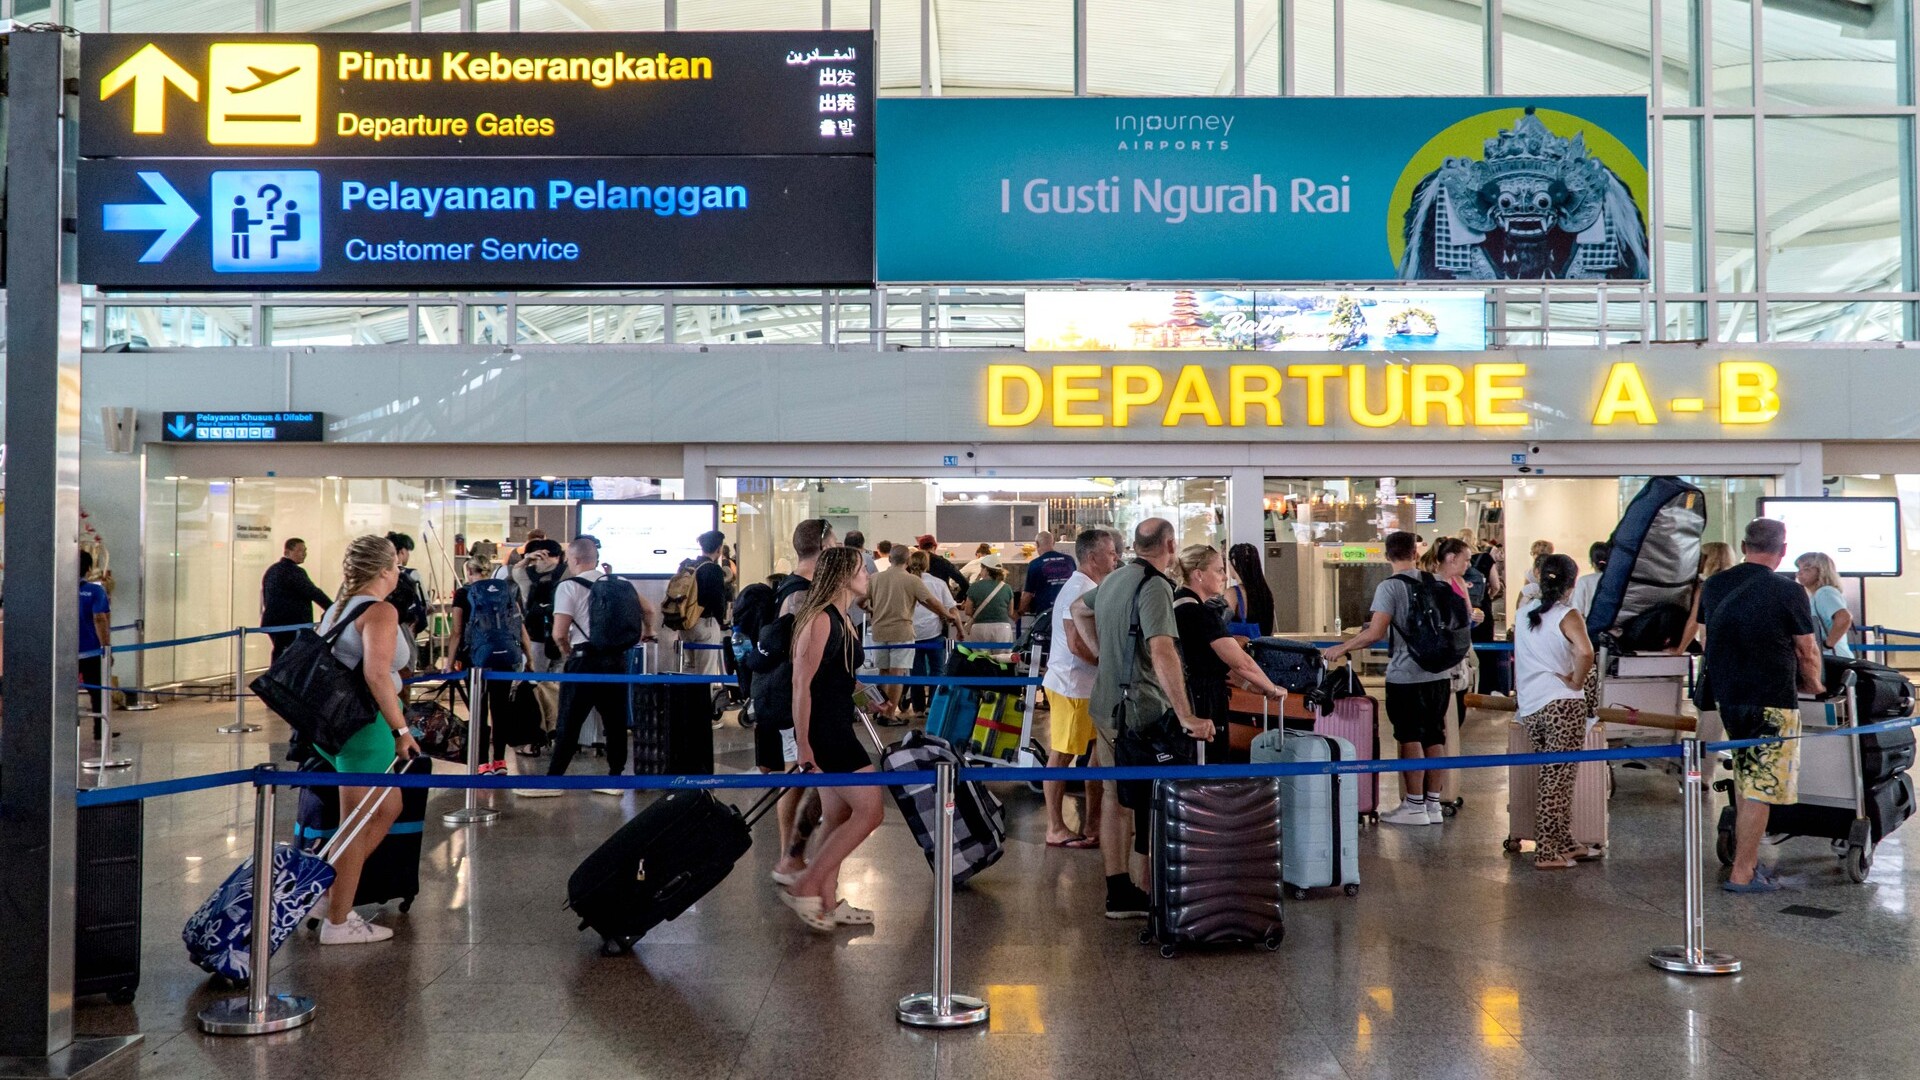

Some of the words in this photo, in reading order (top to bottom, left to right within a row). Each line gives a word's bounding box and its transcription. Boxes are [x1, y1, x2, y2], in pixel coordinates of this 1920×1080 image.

[340, 53, 432, 81] Pintu
[444, 53, 712, 87] Keberangkatan
[820, 68, 855, 86] 出发
[819, 94, 855, 112] 出発
[338, 114, 469, 138] Departure
[477, 114, 555, 137] Gates
[820, 119, 856, 136] 출발
[1118, 141, 1229, 151] AIRPORTS
[341, 182, 537, 218] Pelayanan
[549, 181, 748, 218] Pelanggan
[1002, 180, 1011, 214] I
[1024, 176, 1120, 214] Gusti
[1134, 174, 1277, 224] Ngurah
[1291, 176, 1350, 214] Rai
[345, 239, 476, 262] Customer
[482, 239, 580, 262] Service
[987, 363, 1529, 427] DEPARTURE
[197, 414, 239, 423] Pelayanan
